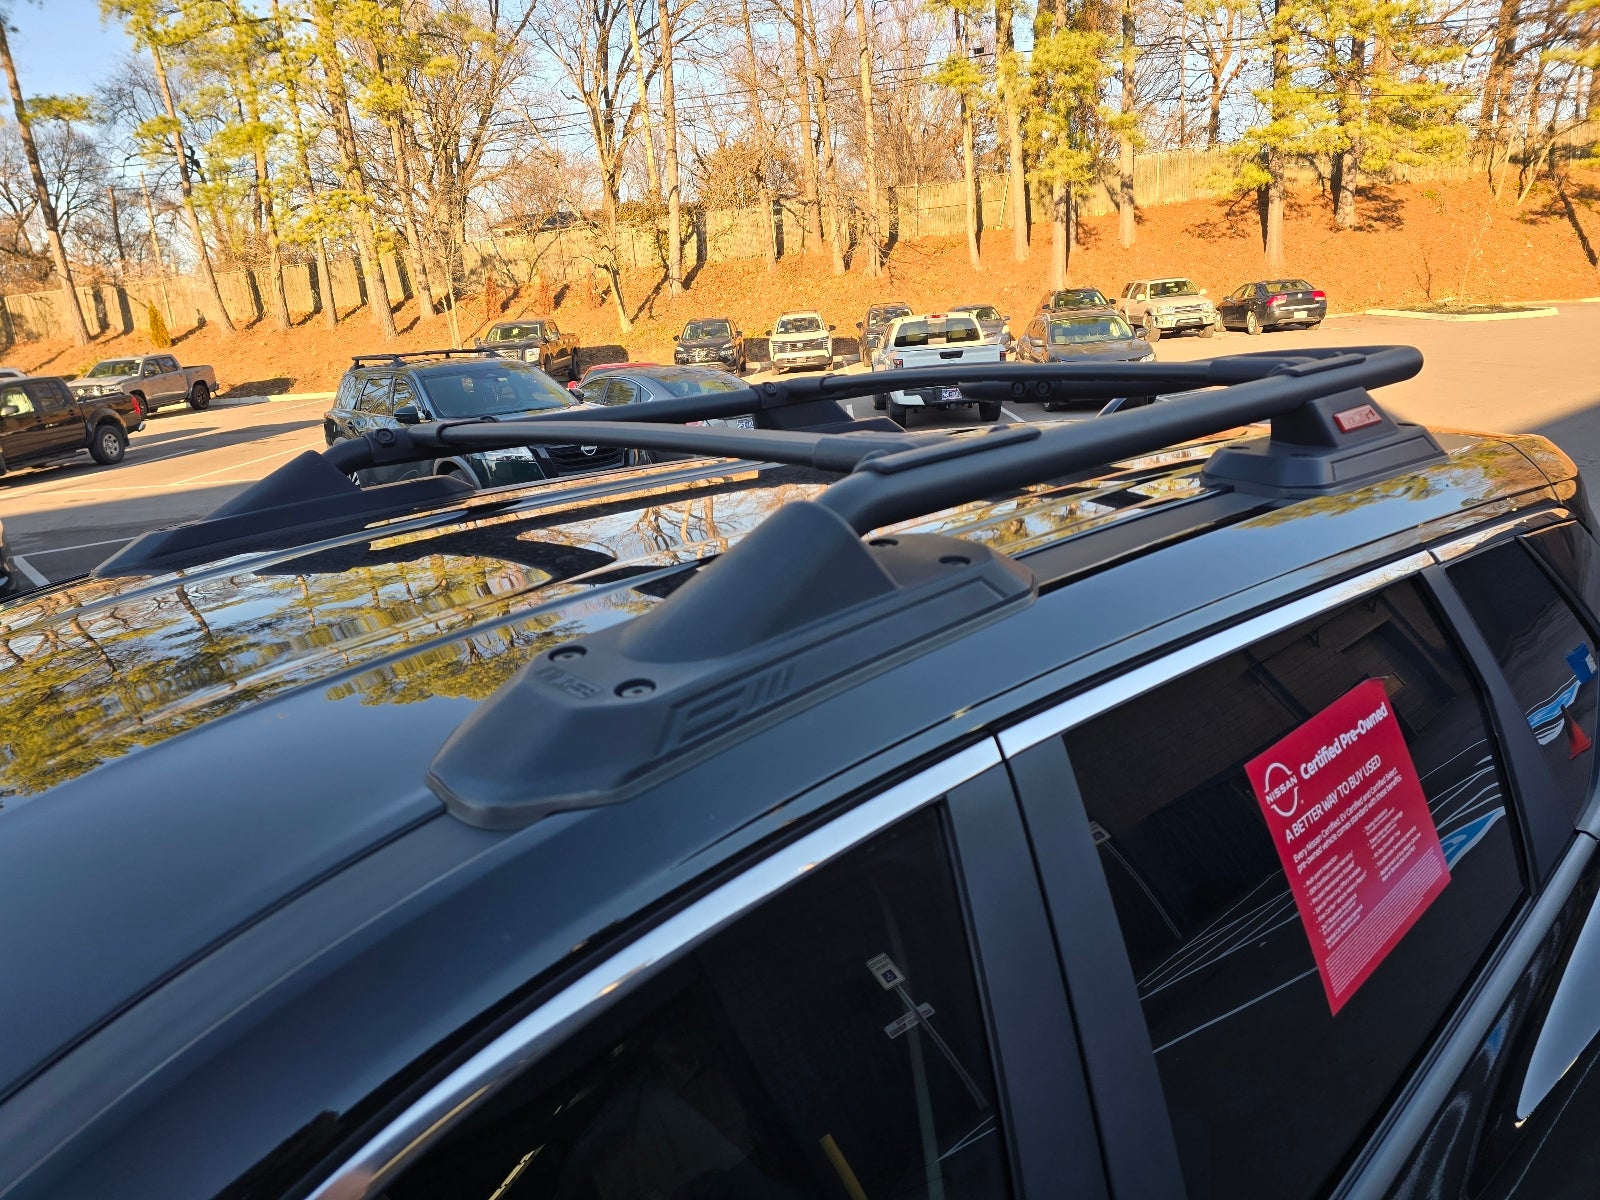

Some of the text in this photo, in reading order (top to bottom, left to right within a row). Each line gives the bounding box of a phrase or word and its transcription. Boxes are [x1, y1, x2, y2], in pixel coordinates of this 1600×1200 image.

[1300, 702, 1388, 780] Certified Pre-Owned
[1265, 775, 1298, 804] NISSAN
[1286, 755, 1381, 844] A BETTER WAY TO BUY USED
[1293, 848, 1307, 863] Every
[1306, 835, 1322, 851] Nissan
[1346, 797, 1363, 816] Certified
[1370, 775, 1387, 794] Certified
[1297, 846, 1323, 875] pre-owned
[1350, 804, 1368, 825] standard
